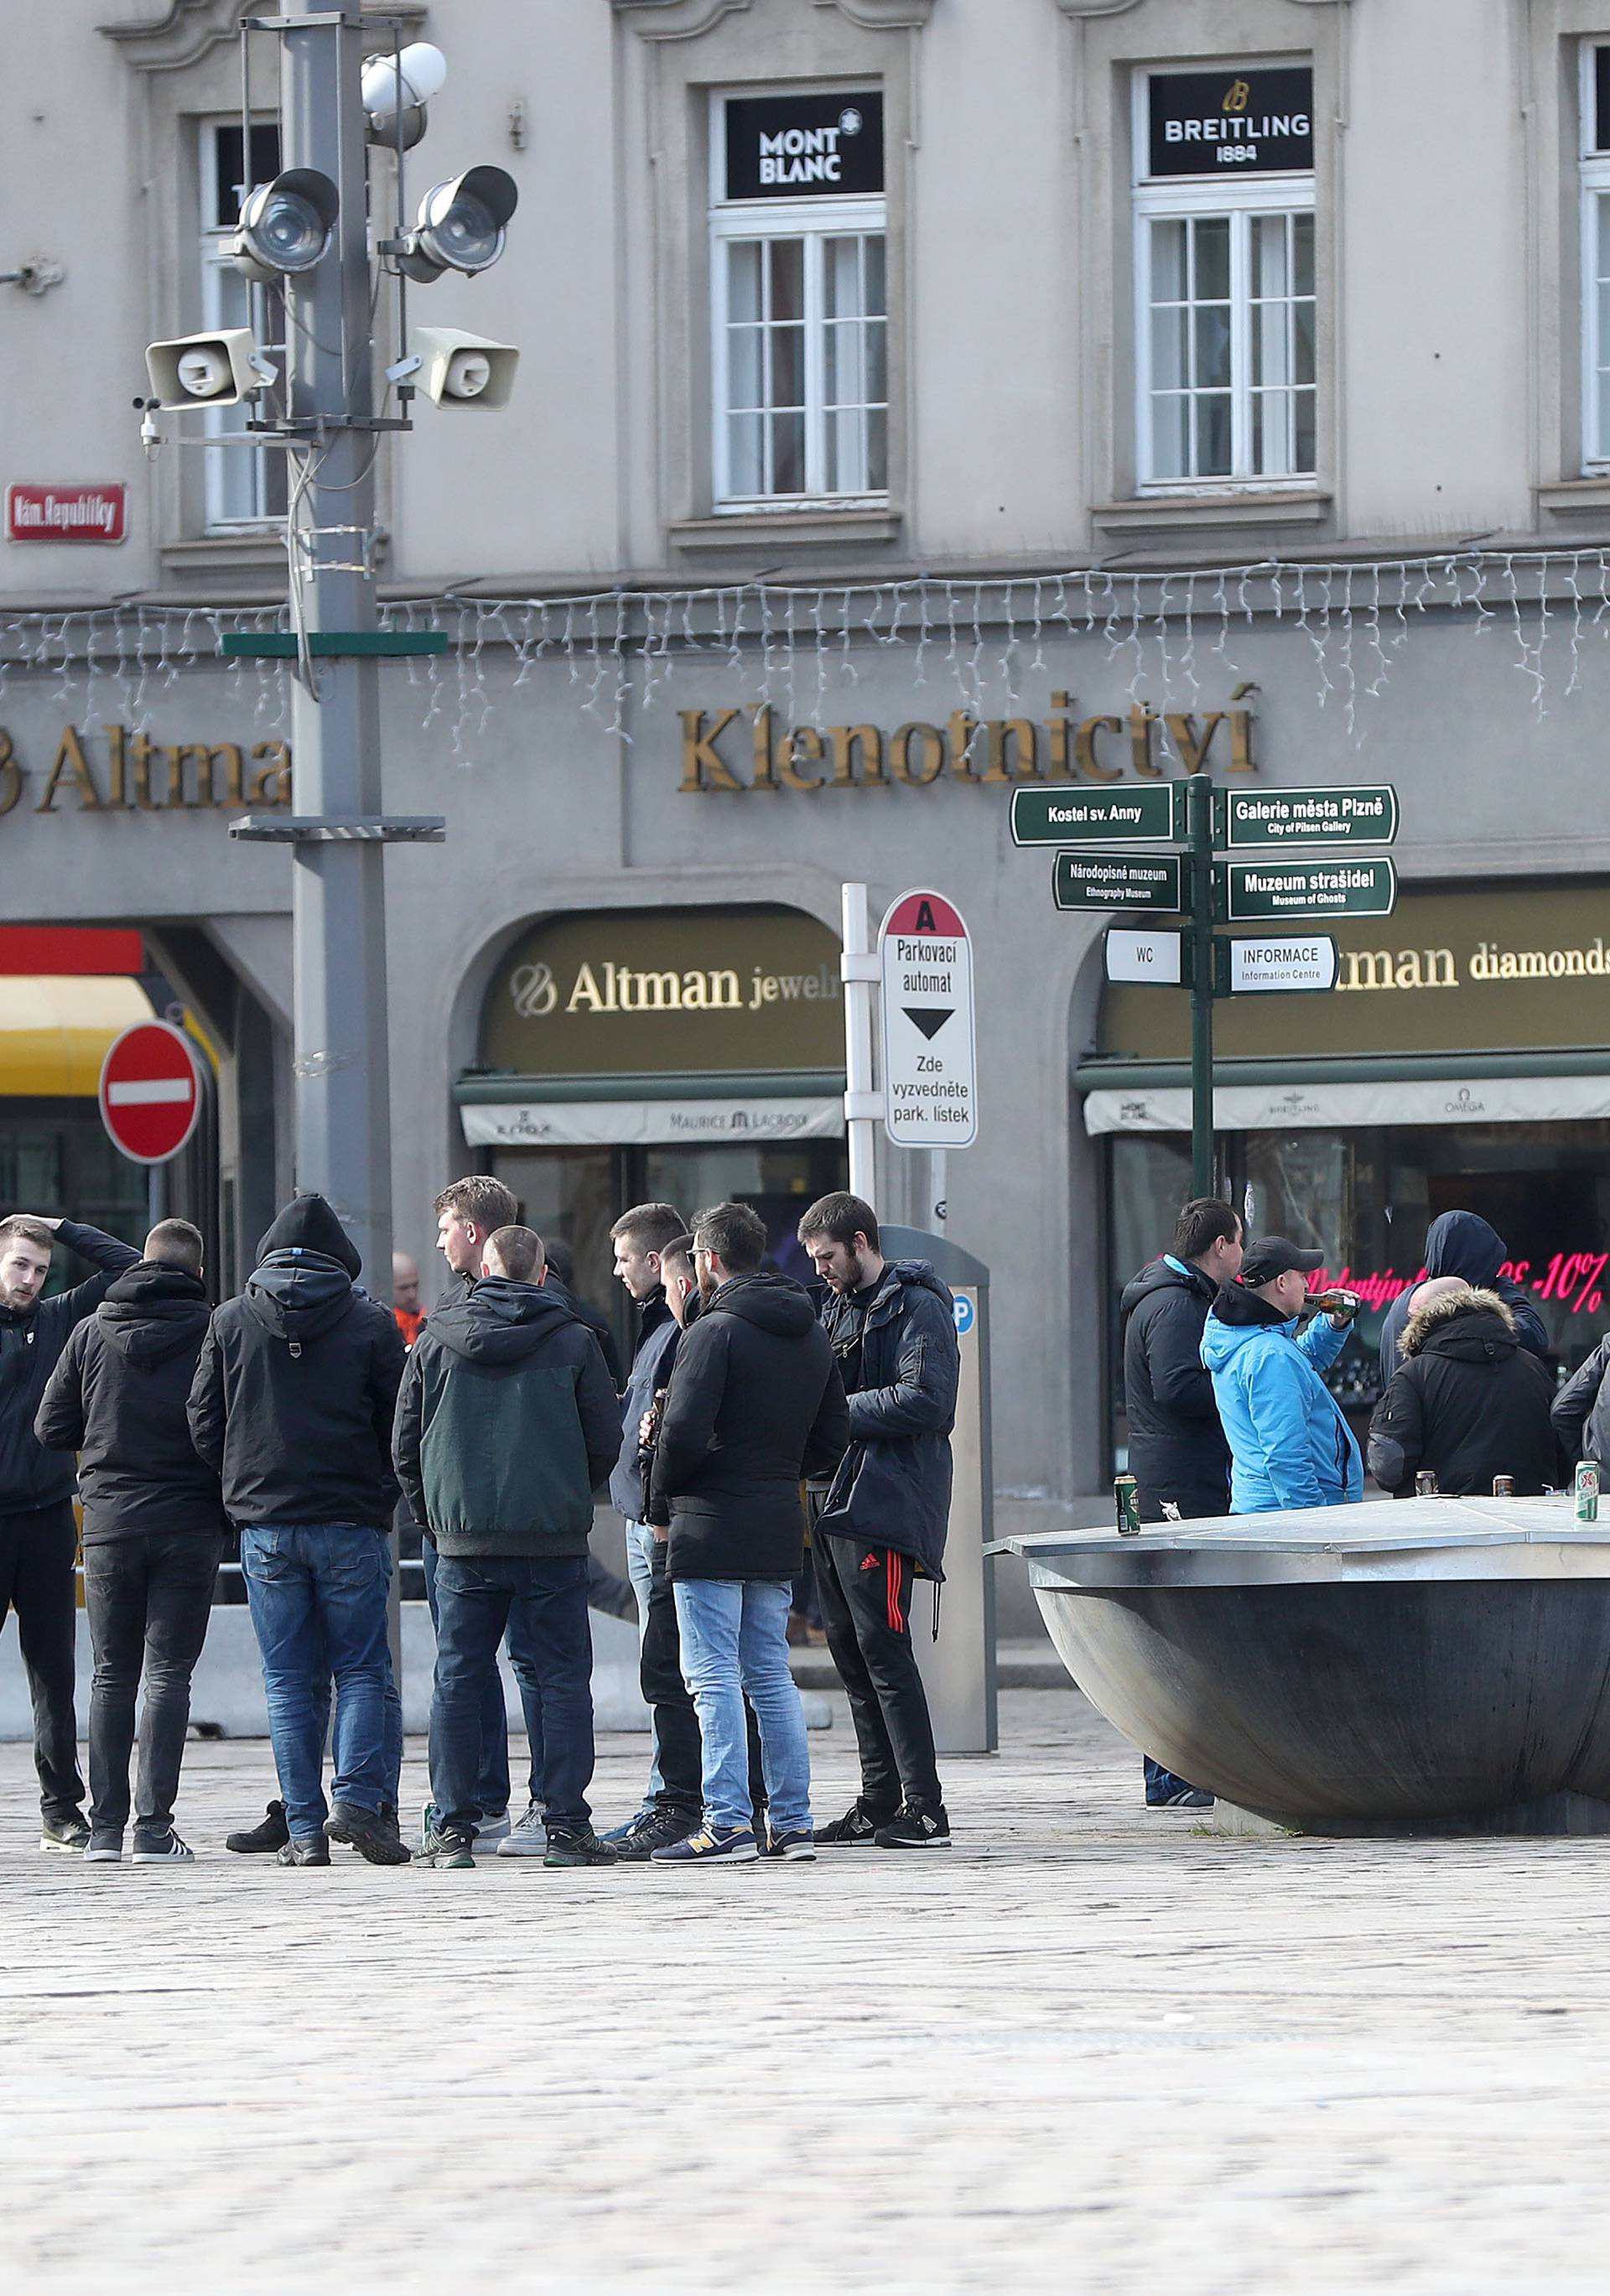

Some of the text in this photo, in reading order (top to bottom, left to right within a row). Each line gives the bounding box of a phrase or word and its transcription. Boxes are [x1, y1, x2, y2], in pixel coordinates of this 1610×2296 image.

[1165, 114, 1310, 142] BREITLING
[760, 127, 839, 156] MONT
[1217, 145, 1257, 163] 1884
[760, 154, 841, 184] BLANC
[678, 683, 1261, 792] Klenotnictví
[1048, 805, 1141, 823] Kostel sv. Anny
[1236, 797, 1384, 819] Galerie města Plzně
[1267, 821, 1352, 835] City of Pilsen Gallery
[1070, 864, 1167, 882] Národopisné muzeum
[1245, 870, 1374, 892] Muzeum strašidel
[1086, 886, 1151, 900] Ethnography Museum
[1272, 893, 1347, 906] Museum of Ghosts
[915, 900, 936, 931] A
[896, 938, 957, 963] Parkovací
[1136, 947, 1153, 963] WC
[1244, 948, 1318, 963] INFORMACE
[903, 971, 951, 993] automat
[1242, 969, 1321, 979] Information Centre
[565, 962, 743, 1013] Altman
[917, 1055, 943, 1073] Zde
[892, 1080, 969, 1099] vyzvedněte
[894, 1104, 969, 1125] park. lístek
